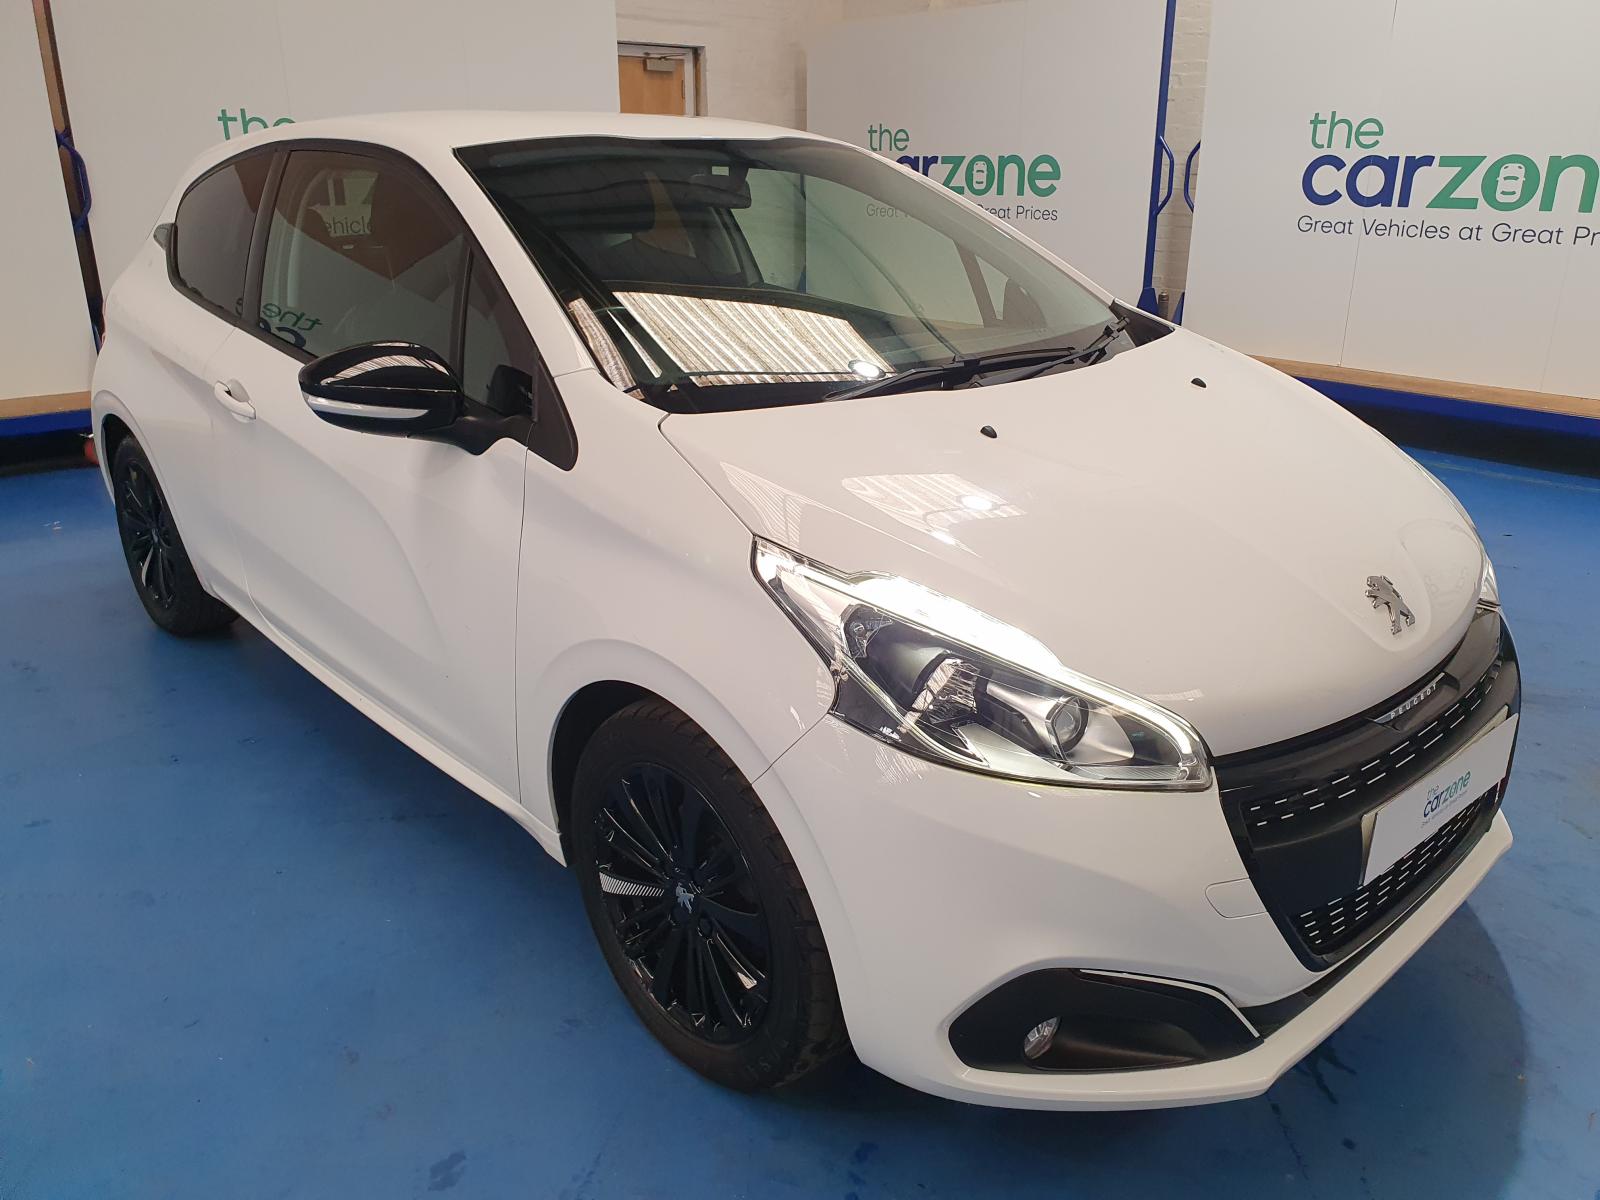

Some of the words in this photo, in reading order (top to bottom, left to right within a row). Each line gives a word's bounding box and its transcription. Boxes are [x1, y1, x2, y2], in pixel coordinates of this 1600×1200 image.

[867, 124, 910, 151] the
[1309, 111, 1384, 149] the
[895, 154, 1061, 197] arzone
[976, 204, 1011, 220] reat
[1016, 205, 1058, 221] Prices
[1297, 215, 1354, 236] Great
[1362, 218, 1451, 240] Vehicles
[1458, 224, 1483, 242] at
[1491, 222, 1564, 246] Great
[1390, 683, 1437, 719] PEUGEOT
[1423, 771, 1471, 818] carzone
